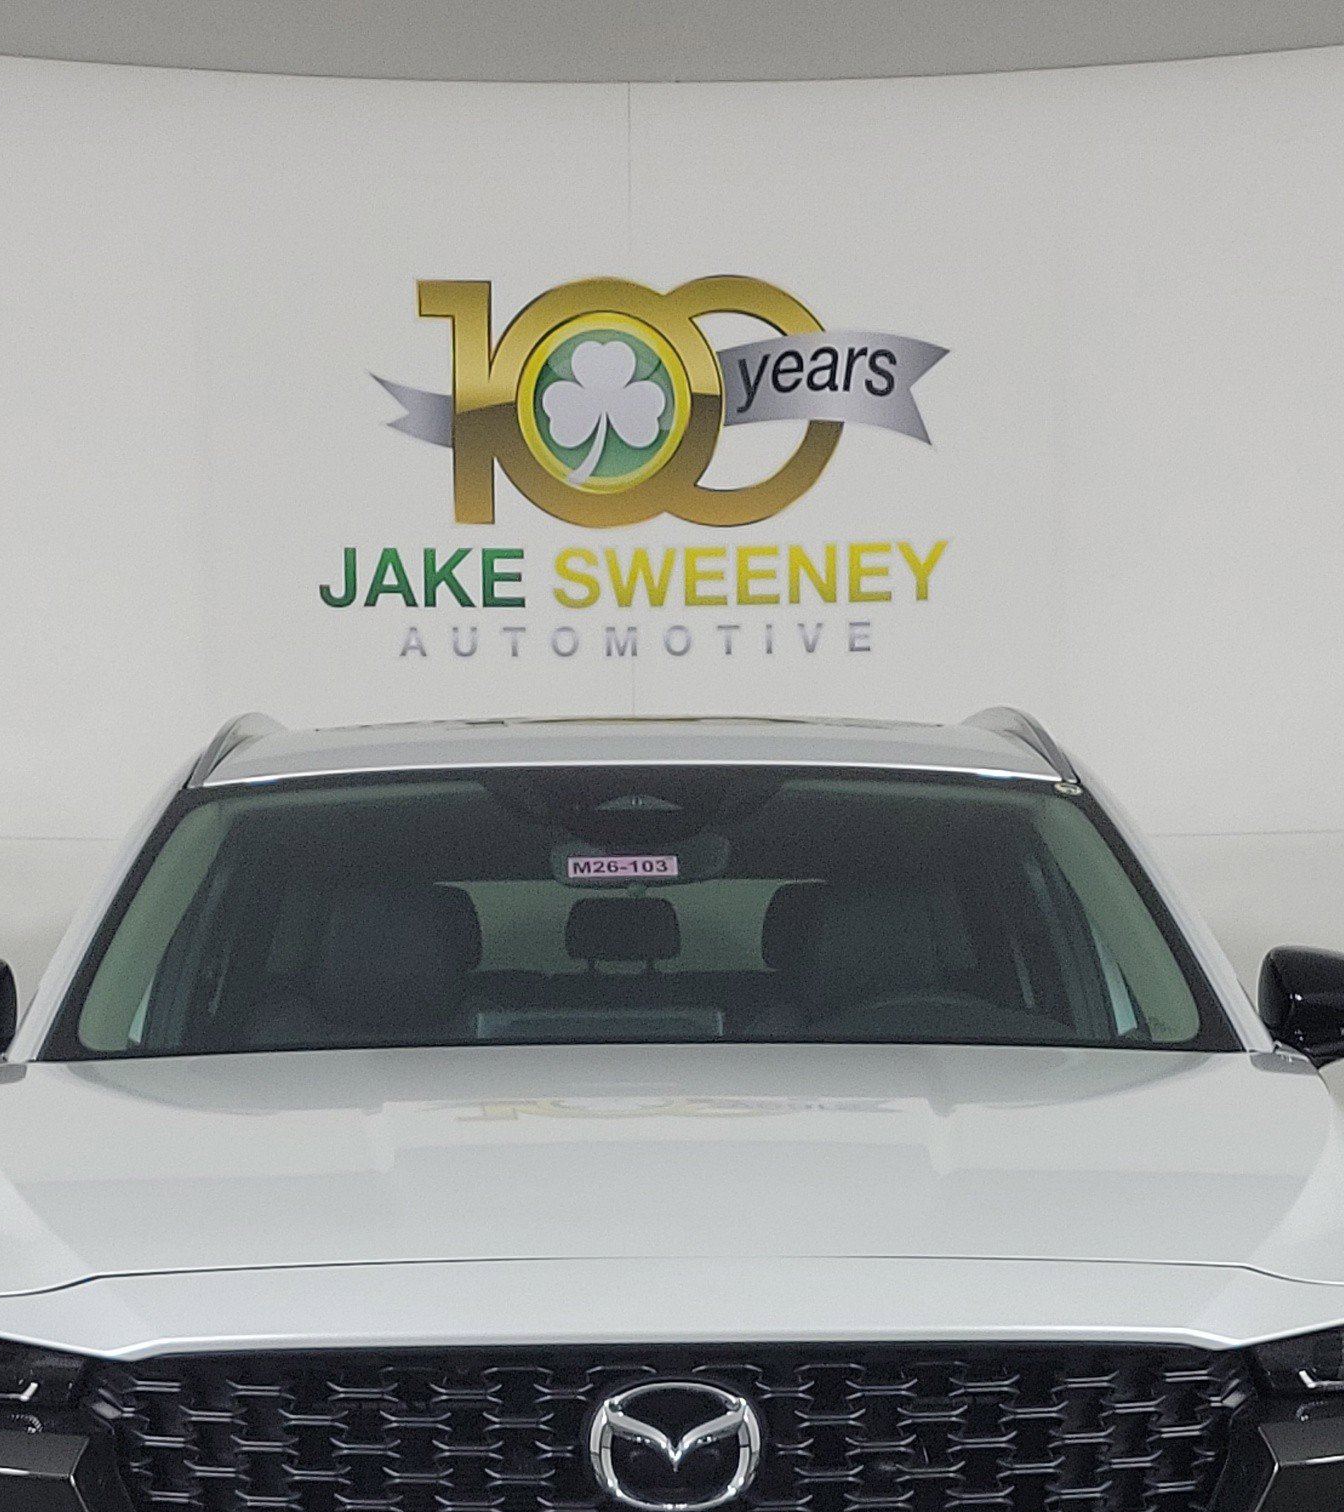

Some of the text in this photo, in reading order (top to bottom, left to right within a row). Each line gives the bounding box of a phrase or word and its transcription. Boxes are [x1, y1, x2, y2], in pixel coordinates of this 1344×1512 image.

[418, 275, 844, 528] 100
[736, 346, 897, 414] years
[318, 541, 949, 610] JAKE SWEENEY
[400, 621, 872, 658] AUTOMOTIVE
[573, 859, 669, 875] M26-103
